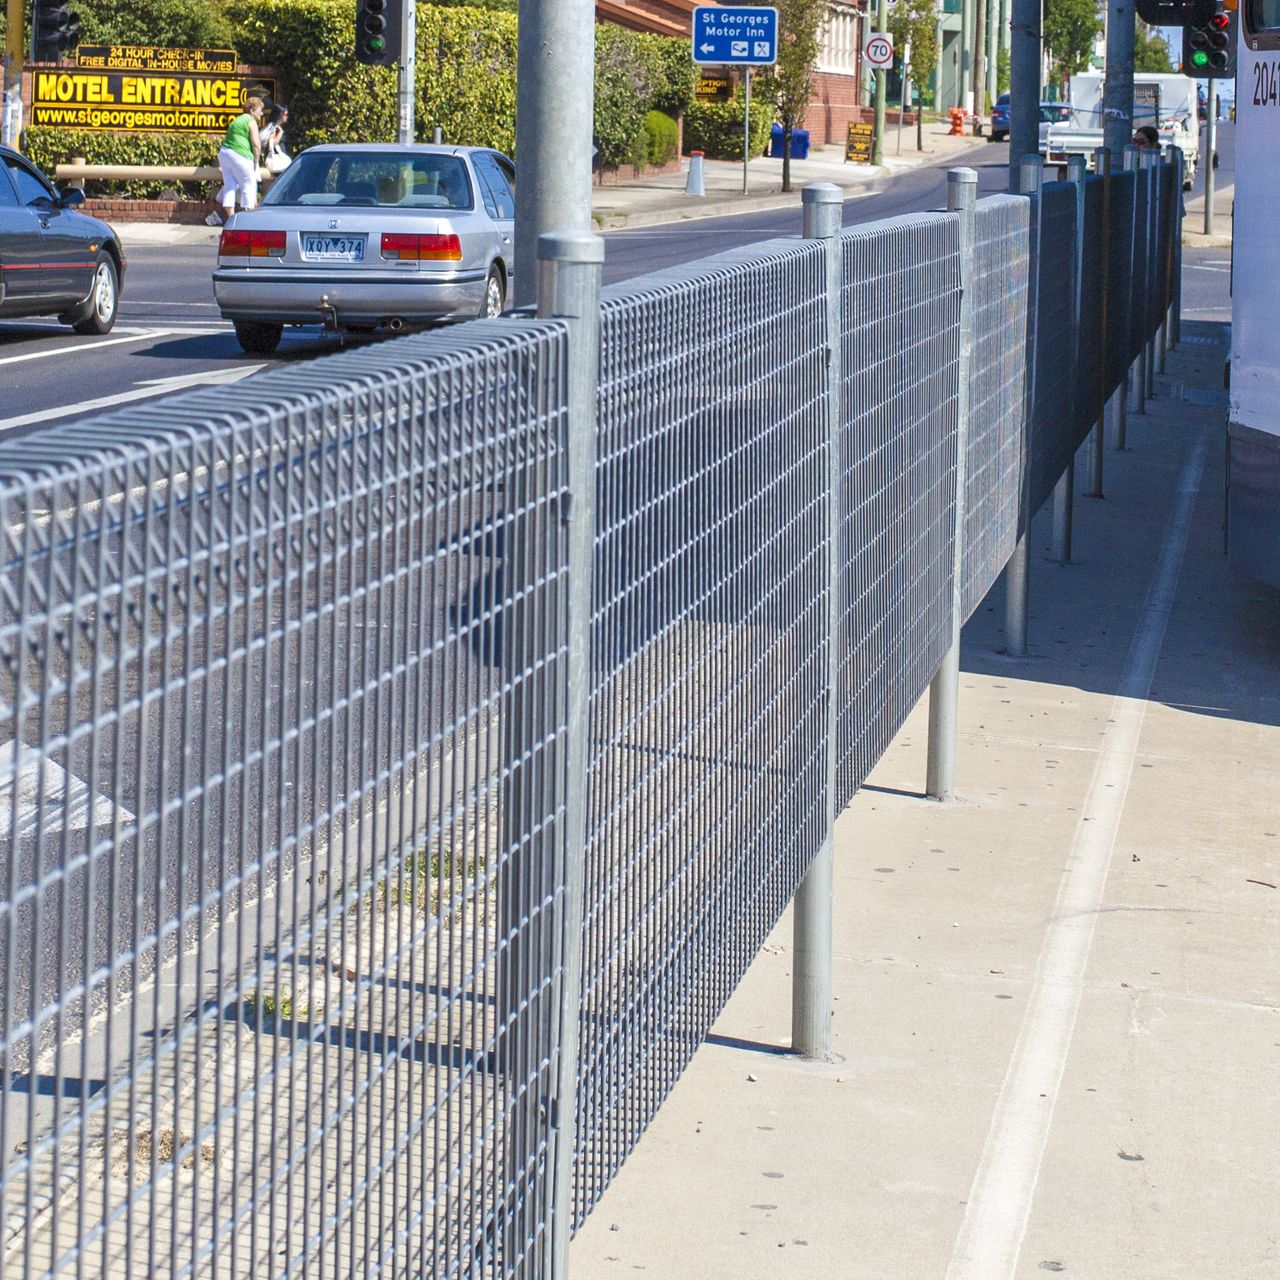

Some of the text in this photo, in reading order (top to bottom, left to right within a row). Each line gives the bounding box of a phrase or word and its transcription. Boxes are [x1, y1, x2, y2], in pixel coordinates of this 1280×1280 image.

[702, 13, 769, 26] St Georges
[706, 26, 764, 37] Motor Inn
[110, 48, 204, 61] 24 HOUR CHECK-IN
[871, 44, 889, 57] 70
[80, 56, 232, 71] FREE DIGITAL IN-HOUSE MOVIES
[38, 74, 240, 106] MOTEL ENTRANCE
[37, 107, 237, 128] www.stgeorgesmotorinn.co
